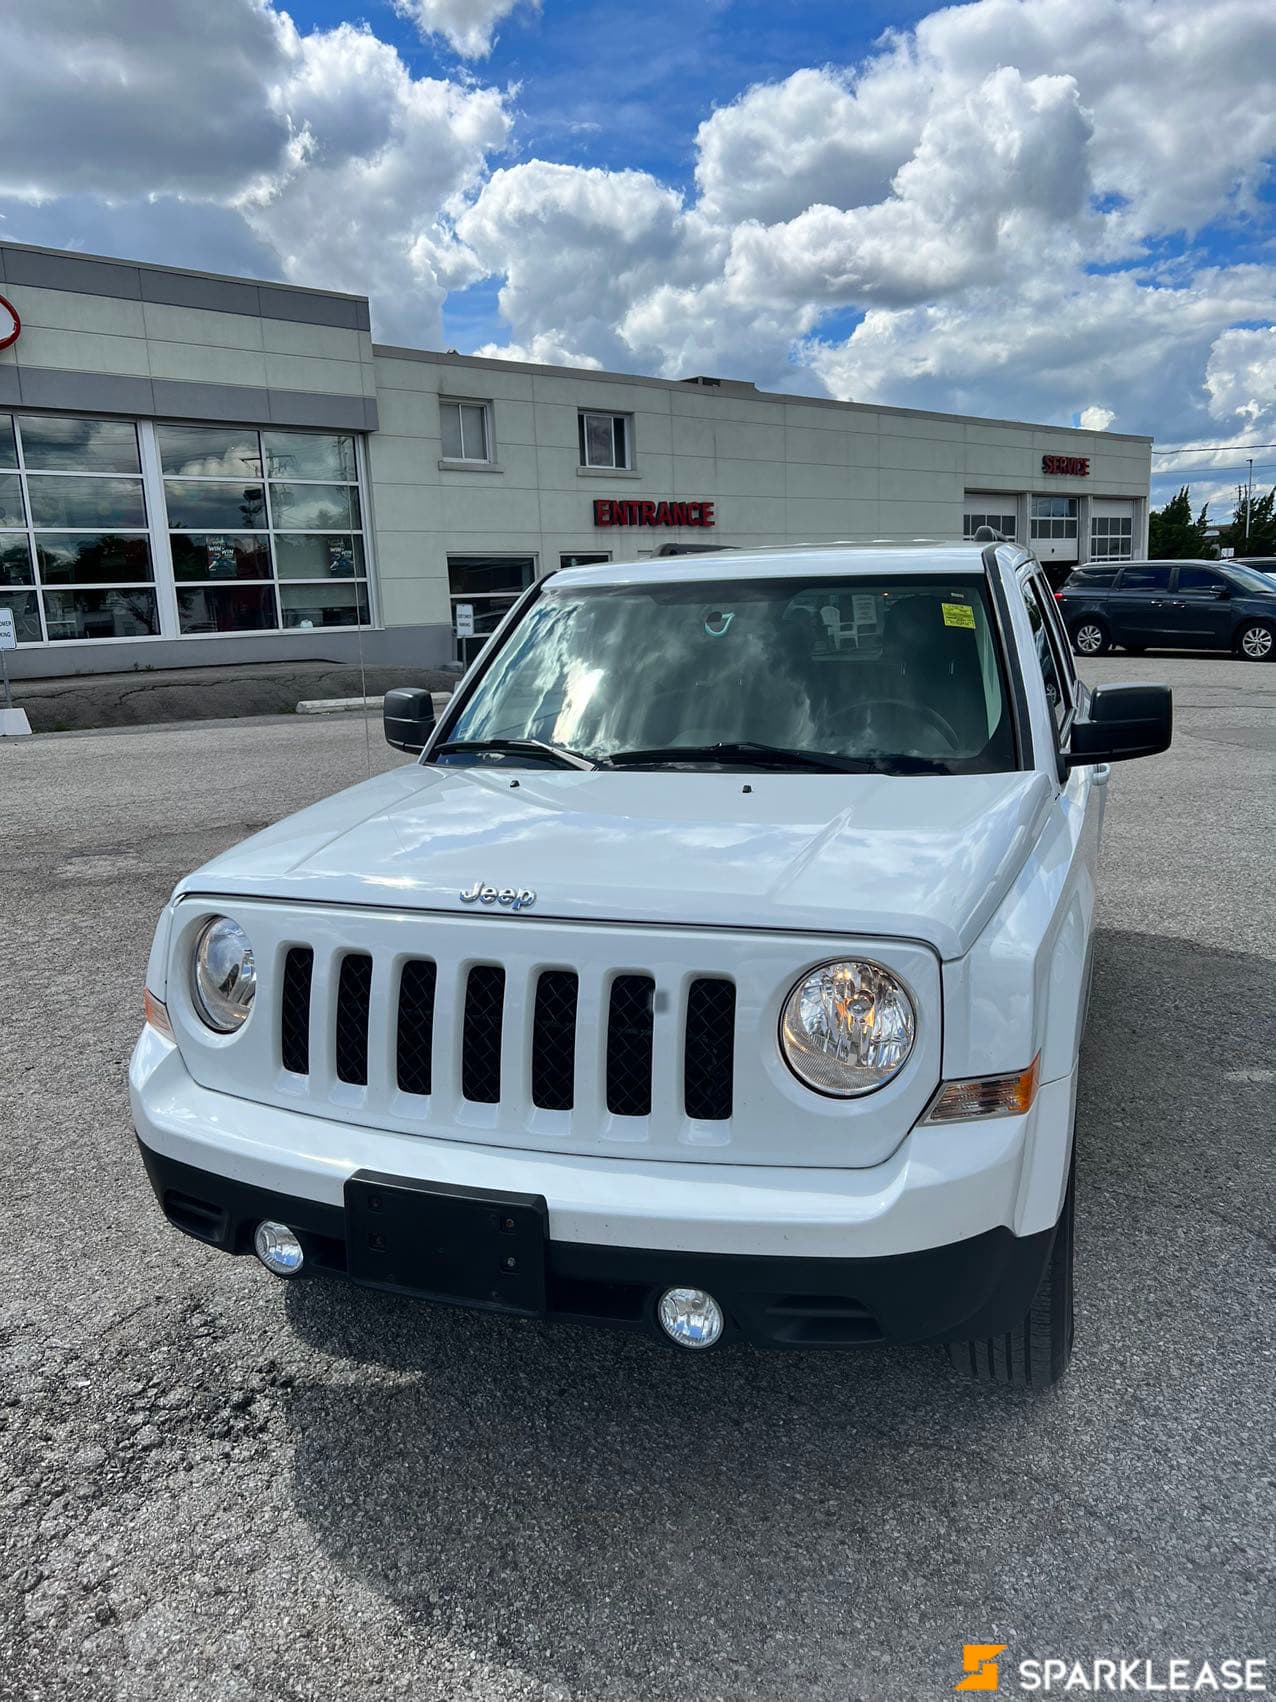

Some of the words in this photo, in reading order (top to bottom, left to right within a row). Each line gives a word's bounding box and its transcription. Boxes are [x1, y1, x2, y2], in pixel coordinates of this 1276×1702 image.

[1042, 455, 1090, 477] SERVICE
[593, 499, 716, 527] ENTRANCE
[459, 880, 537, 912] Jeep
